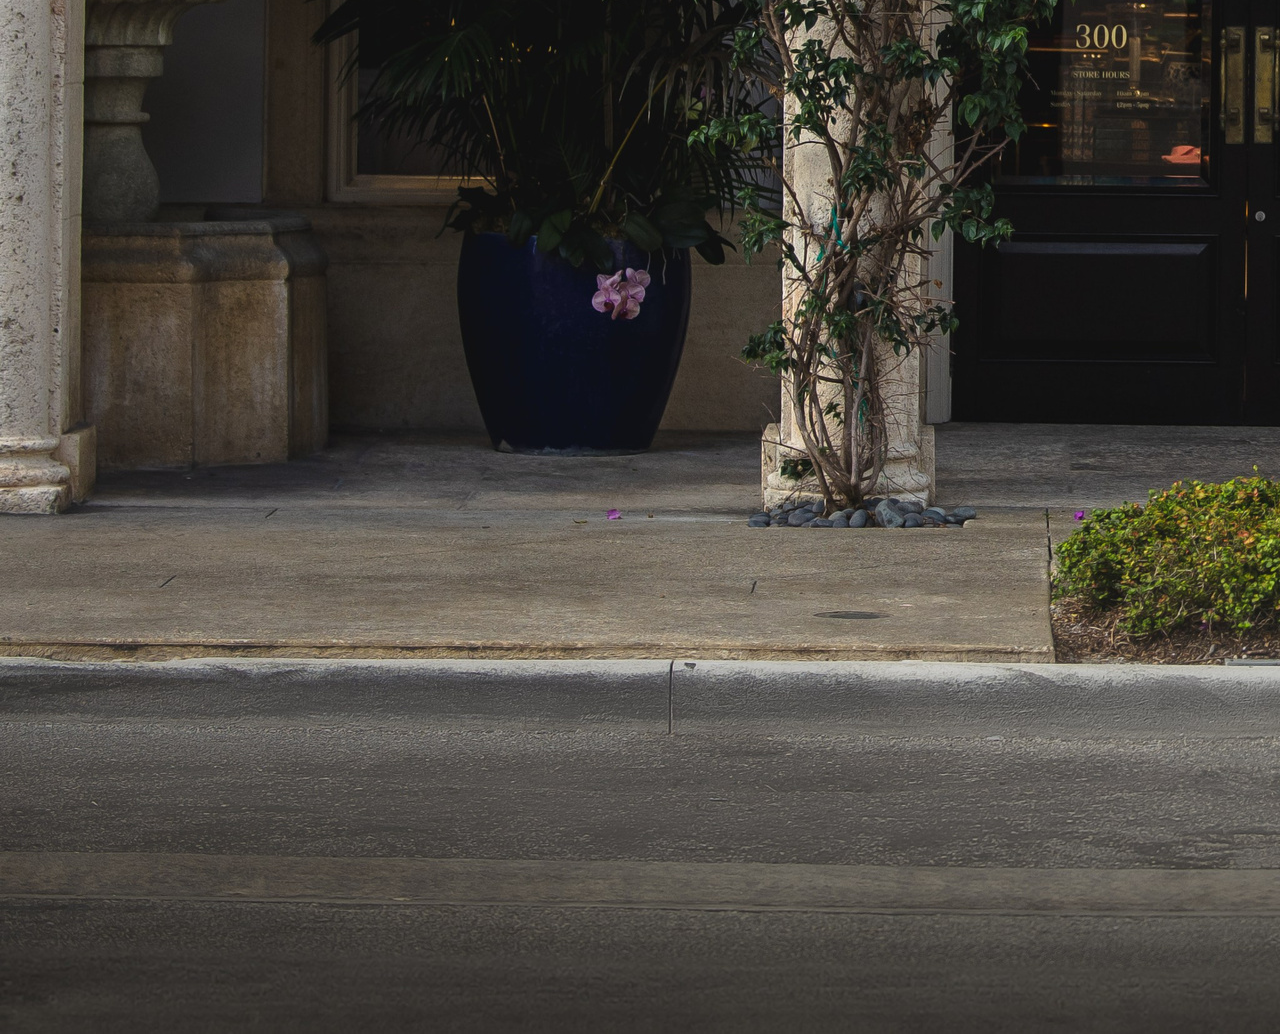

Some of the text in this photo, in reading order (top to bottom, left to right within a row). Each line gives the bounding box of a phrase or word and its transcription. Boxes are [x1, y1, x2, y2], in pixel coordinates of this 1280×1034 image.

[1075, 23, 1128, 49] 300
[1073, 70, 1131, 79] STORE HOURS
